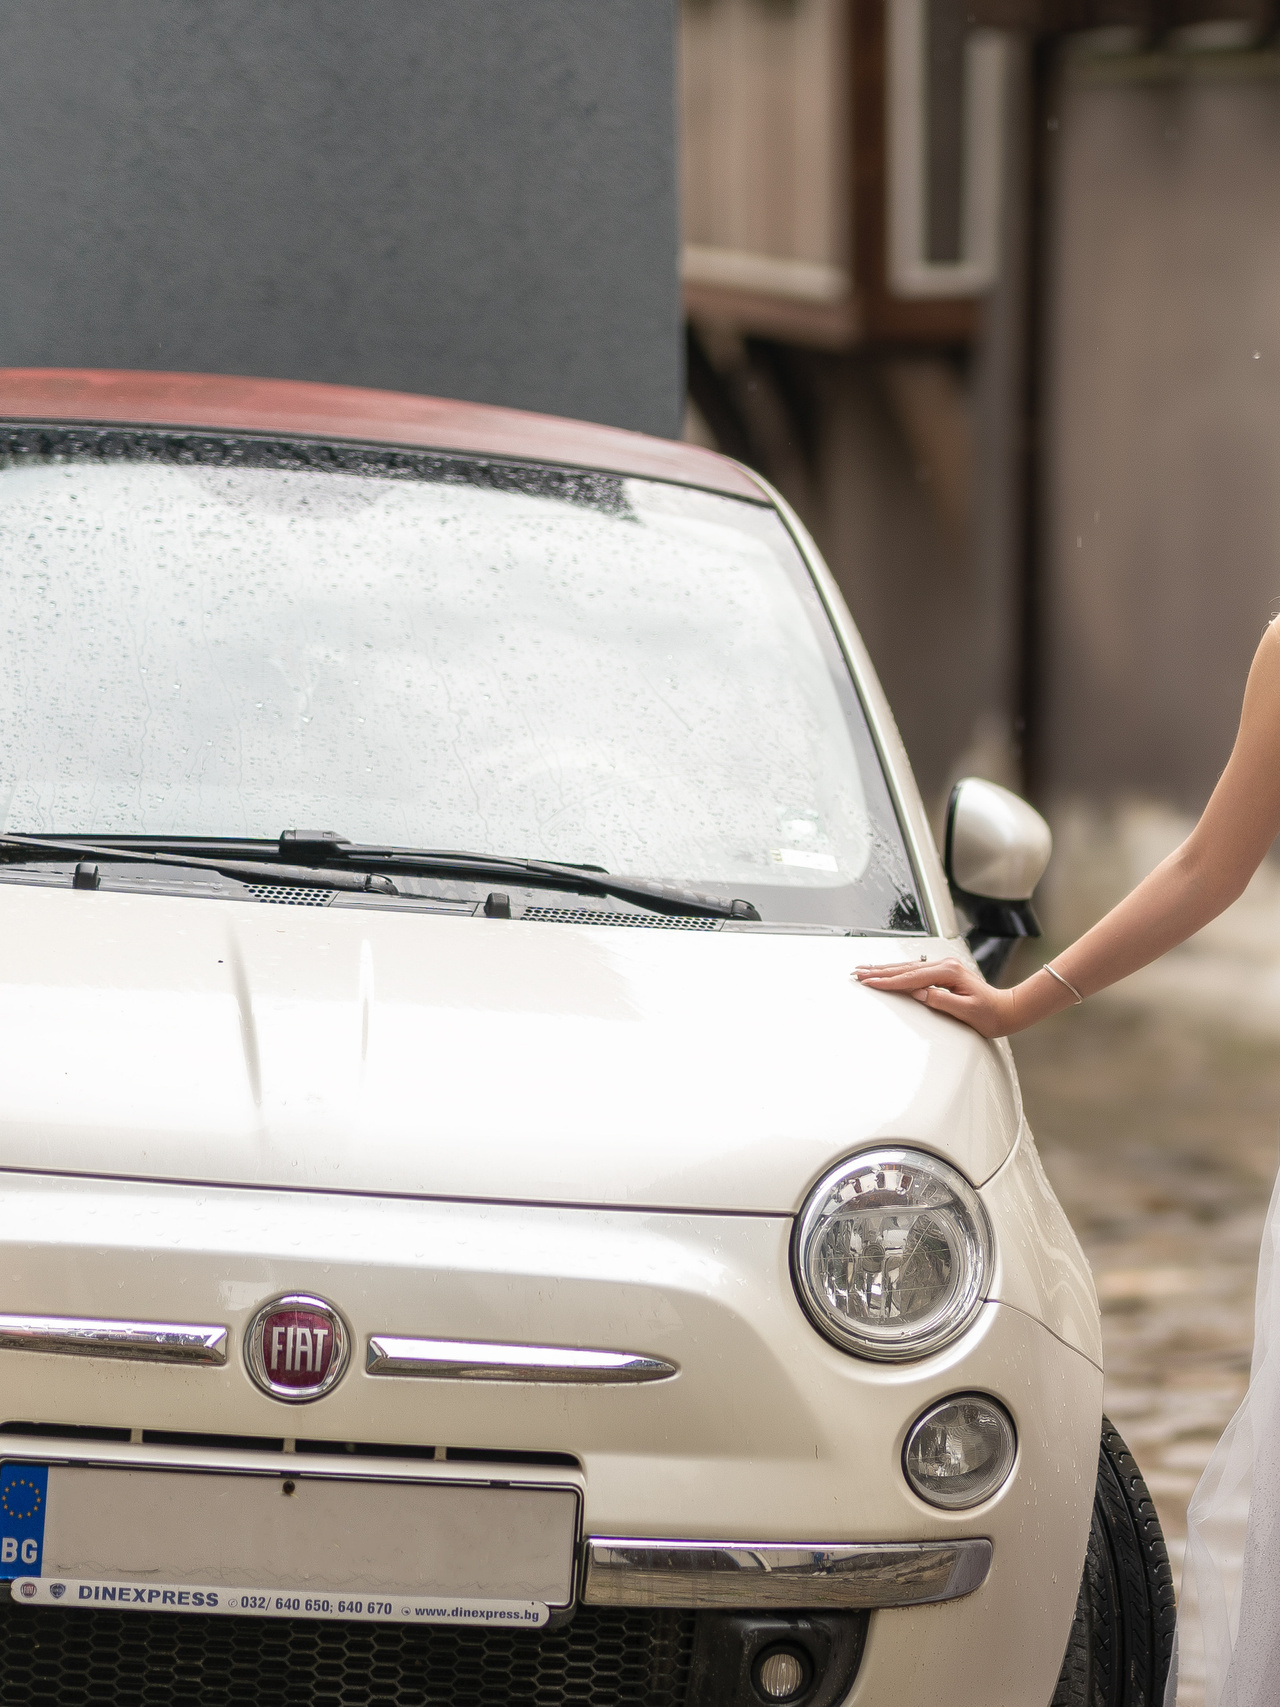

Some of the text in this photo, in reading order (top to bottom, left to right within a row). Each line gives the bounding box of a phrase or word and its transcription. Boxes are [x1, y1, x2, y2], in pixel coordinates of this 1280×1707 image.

[270, 1326, 329, 1372] FIAT
[1, 1537, 38, 1564] BG
[78, 1585, 219, 1607] DINEXPRESS
[240, 1595, 272, 1611] 032/
[275, 1597, 300, 1611] 640
[304, 1599, 334, 1614] 650;
[337, 1600, 363, 1613] 640
[367, 1602, 393, 1616] 670
[414, 1606, 540, 1622] www.dinexpress.bg
